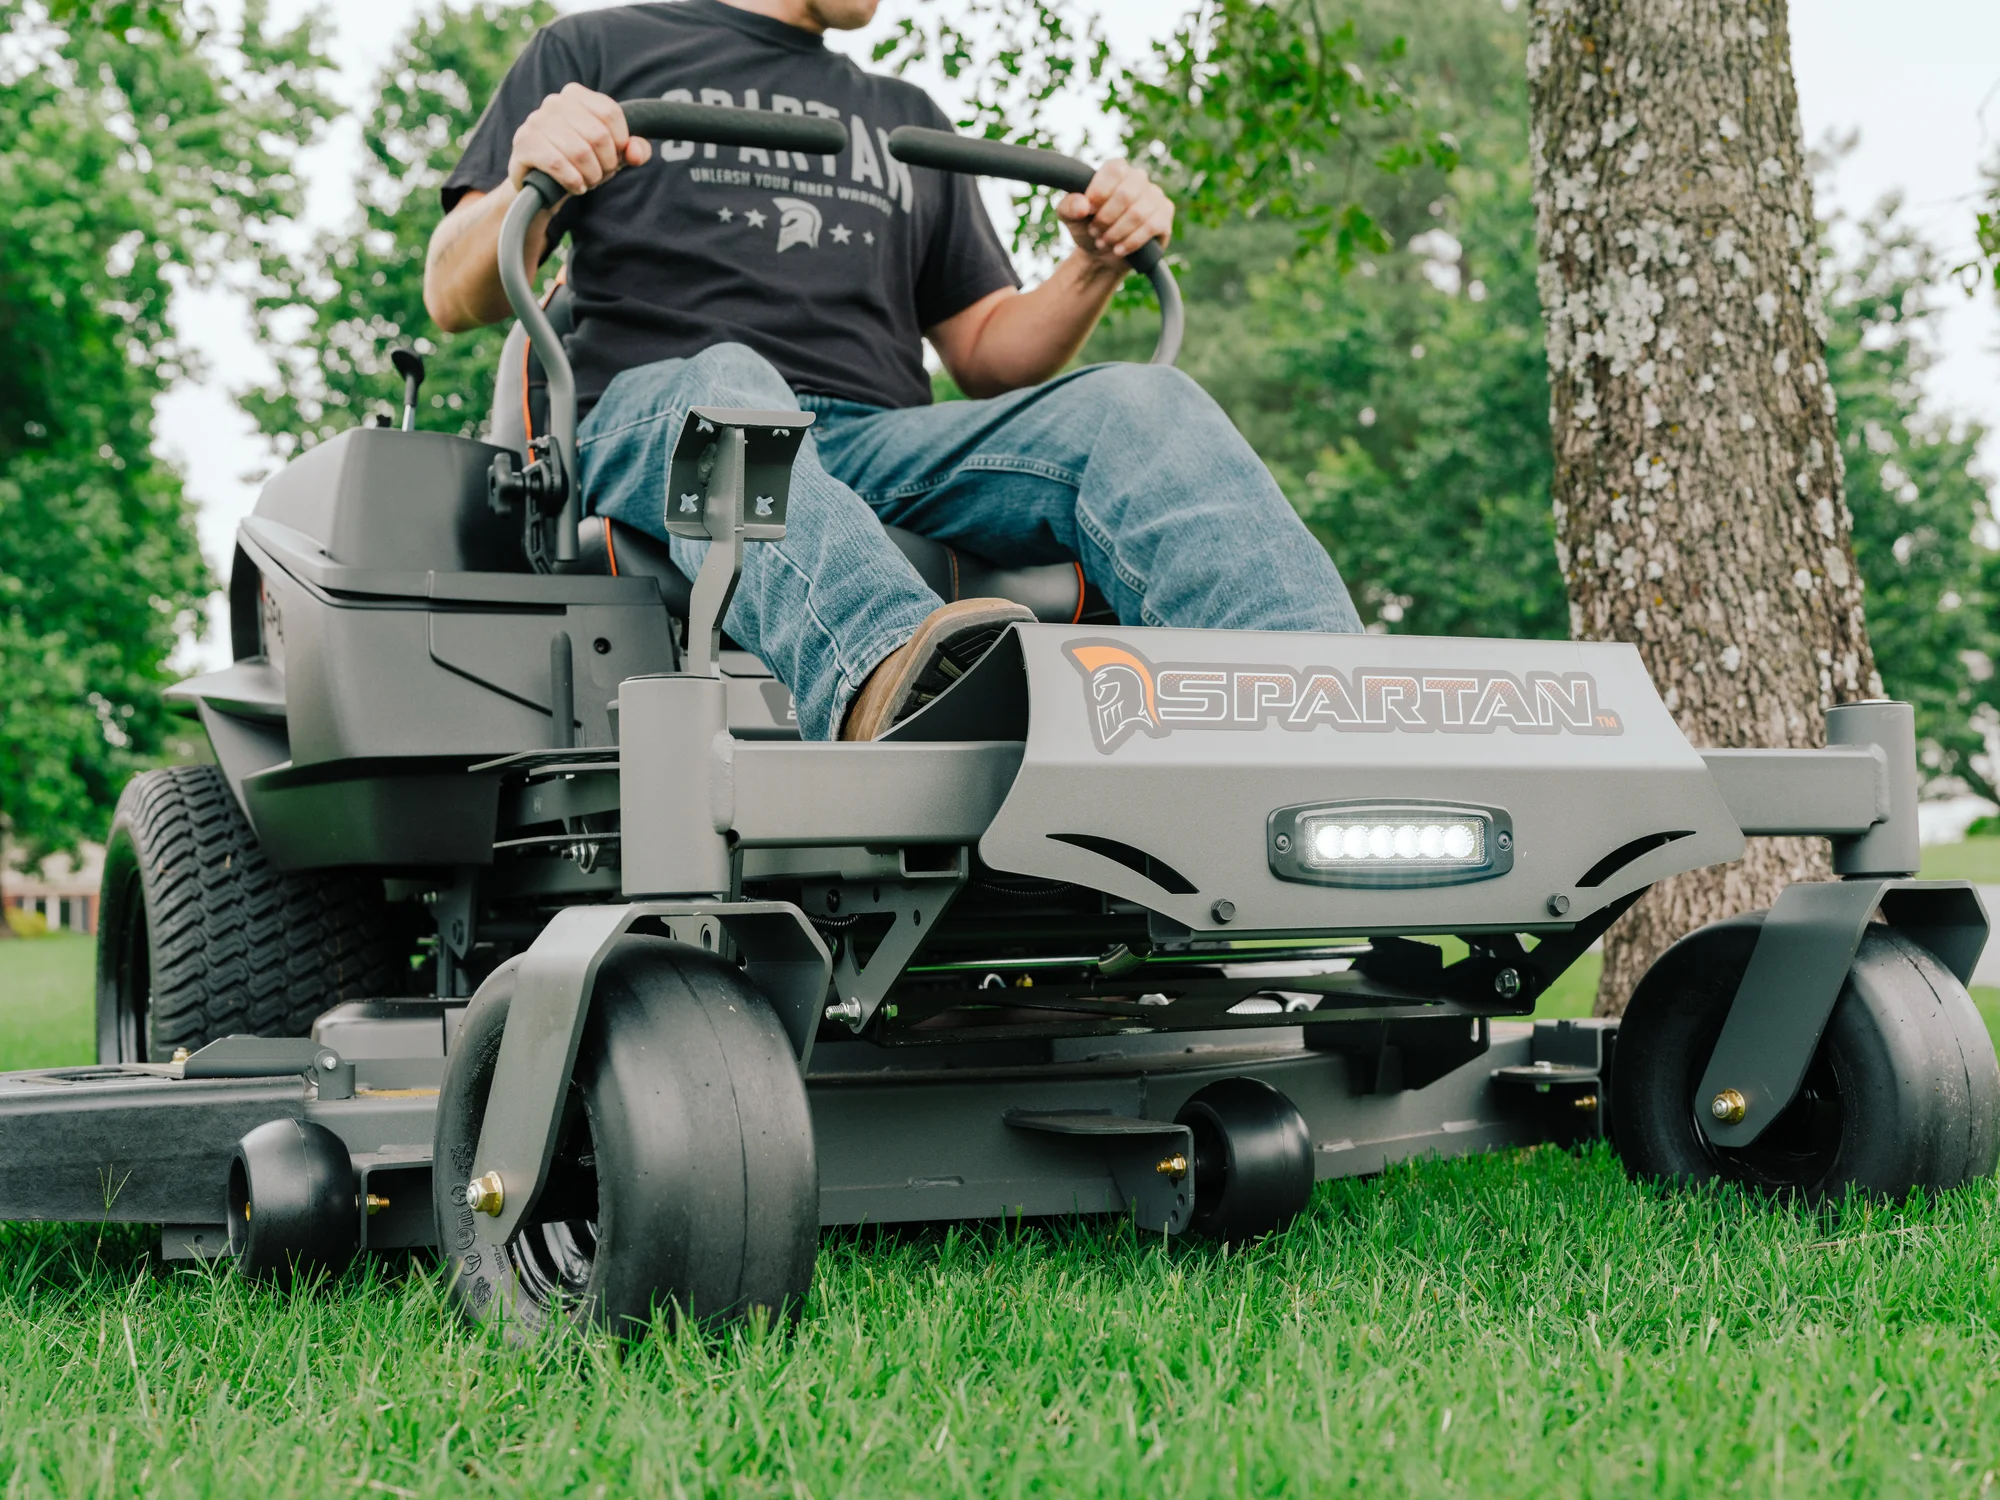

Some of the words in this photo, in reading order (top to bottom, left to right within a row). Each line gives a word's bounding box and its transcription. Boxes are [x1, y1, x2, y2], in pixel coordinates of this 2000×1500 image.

[690, 167, 750, 186] UNLEASH
[754, 173, 790, 191] YOUR
[793, 179, 833, 198] INNER
[1157, 670, 1593, 727] SPARTAN
